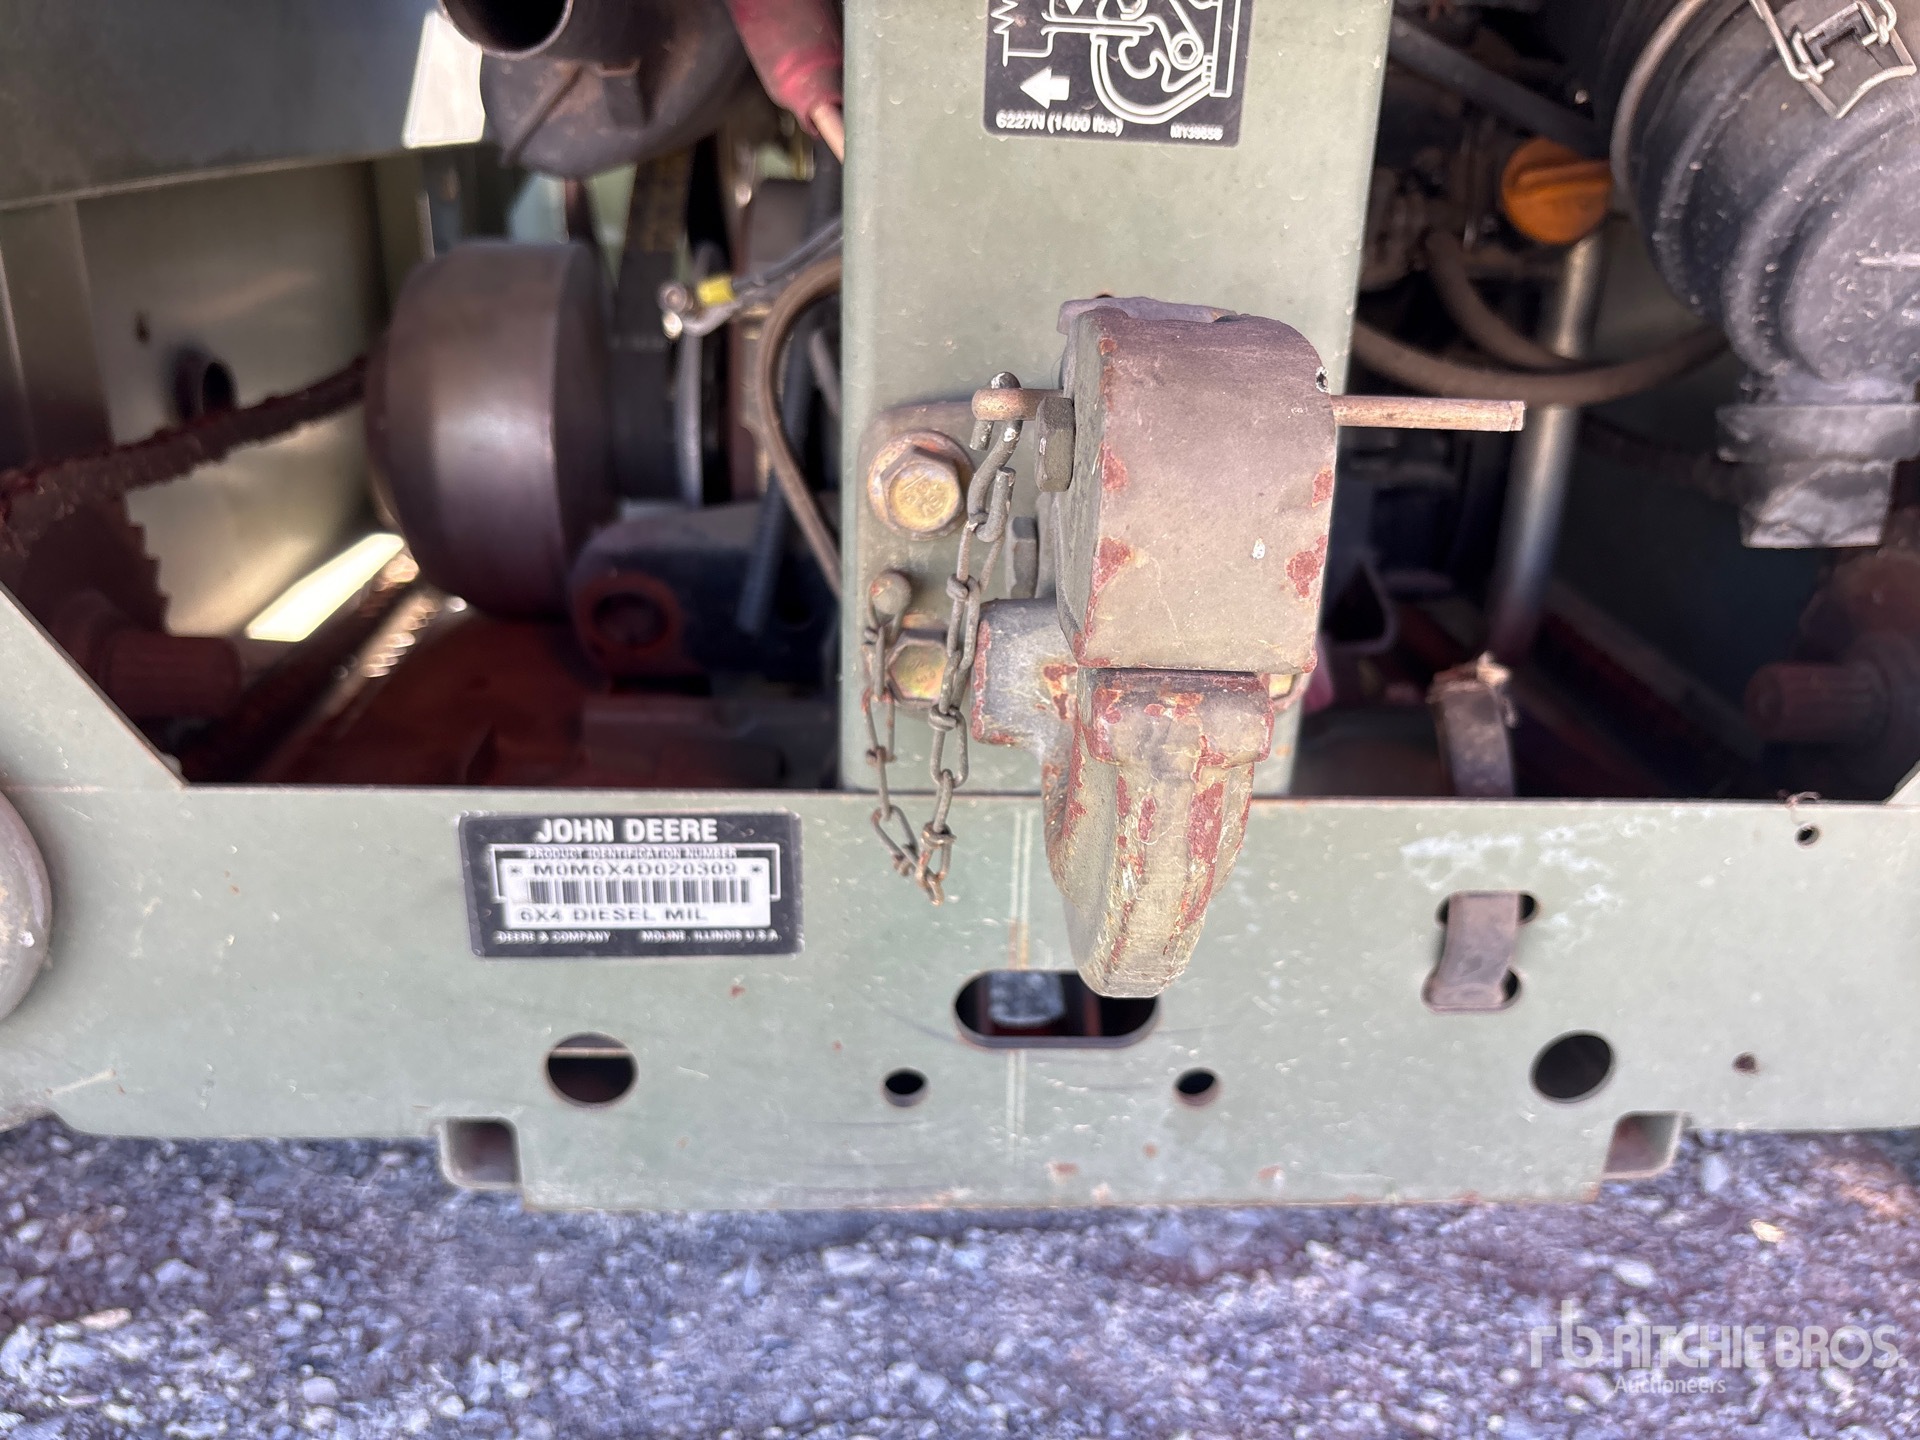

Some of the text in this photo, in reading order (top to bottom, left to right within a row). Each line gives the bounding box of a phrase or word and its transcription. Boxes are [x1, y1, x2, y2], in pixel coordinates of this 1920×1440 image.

[996, 110, 1124, 137] 6227N (1400 lbs)
[535, 818, 719, 843] JOHN DEERE
[526, 847, 738, 859] PRODUCT IDENTIFICATION NUMBER
[519, 907, 708, 921] 6X4 DIESEL MIL
[495, 930, 536, 943] DEERE
[551, 930, 612, 943] COMPANY
